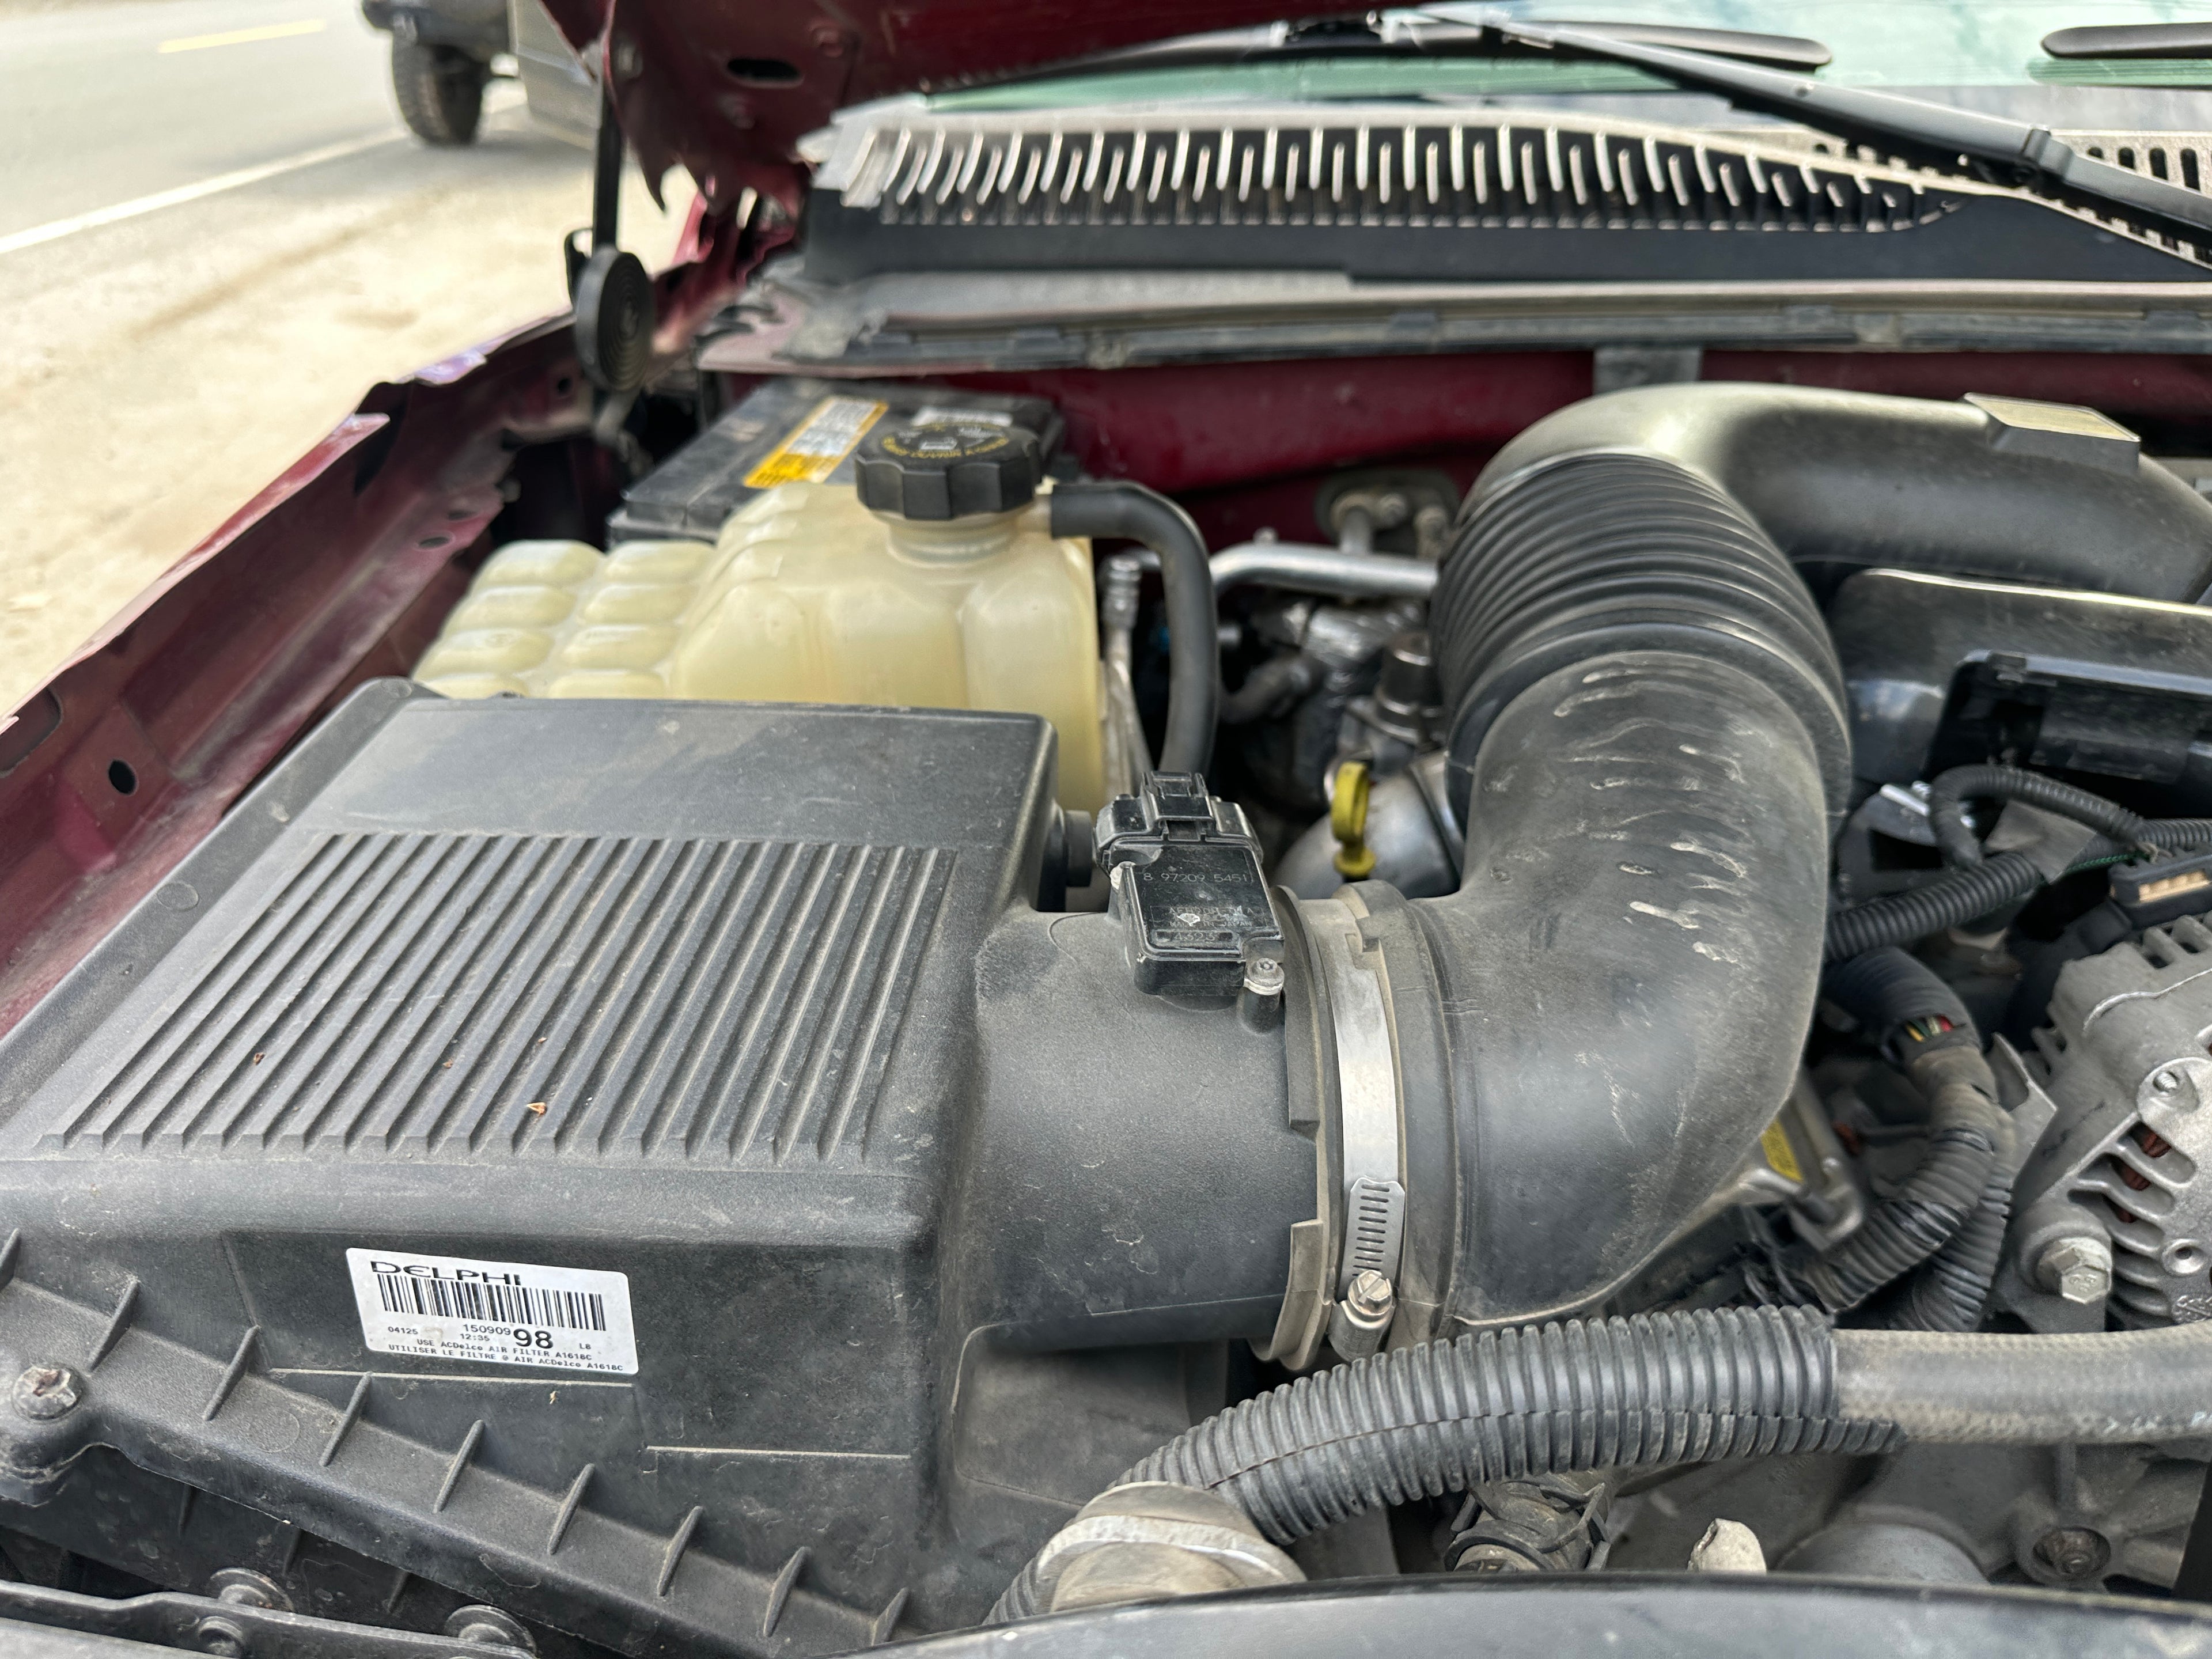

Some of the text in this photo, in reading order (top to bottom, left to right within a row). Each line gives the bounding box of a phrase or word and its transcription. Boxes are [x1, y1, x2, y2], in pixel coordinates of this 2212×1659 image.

[1143, 873, 1153, 881] 8
[370, 1260, 522, 1286] DELPHI
[388, 1326, 418, 1335] 04125
[460, 1333, 490, 1342] 12:35
[389, 1344, 437, 1354] UTILISER
[460, 1351, 497, 1359] FILTRE
[539, 1358, 581, 1368] ACDelco
[587, 1363, 623, 1371] A1618C
[441, 1341, 483, 1351] ACDelco
[513, 1348, 550, 1357] FILTER
[555, 1351, 592, 1360] A1618C
